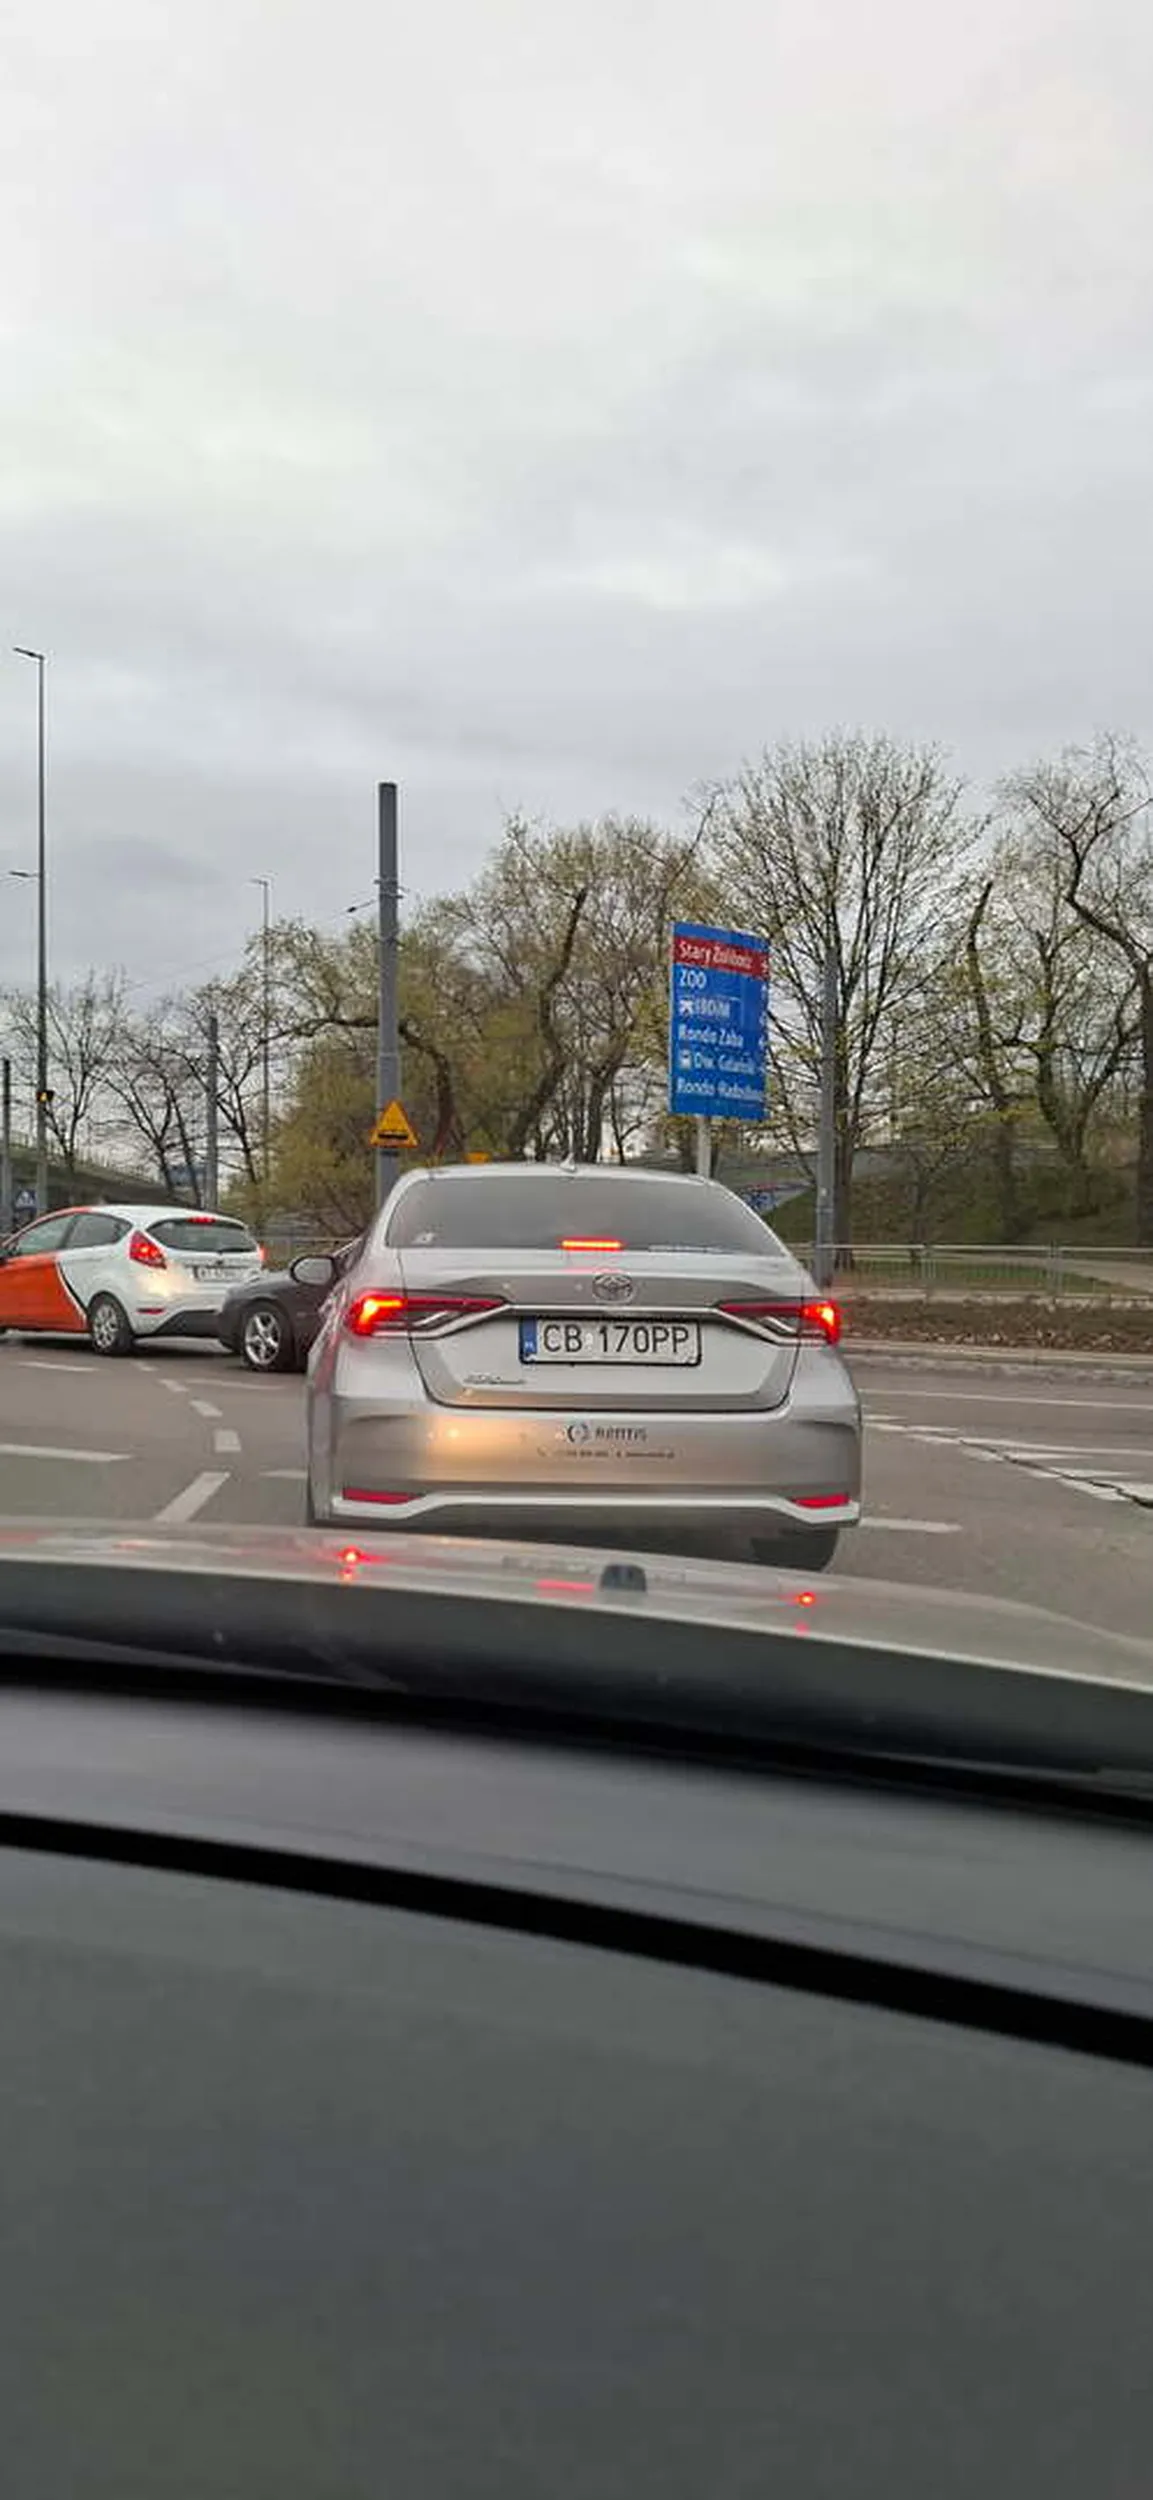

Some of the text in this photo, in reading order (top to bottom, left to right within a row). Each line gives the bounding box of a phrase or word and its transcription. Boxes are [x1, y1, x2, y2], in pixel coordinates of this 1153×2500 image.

[679, 940, 711, 964] Stary
[679, 968, 708, 990] ZOO
[678, 1024, 718, 1044] Rondo
[677, 1077, 715, 1097] Rondo
[543, 1324, 690, 1353] CB 170PP
